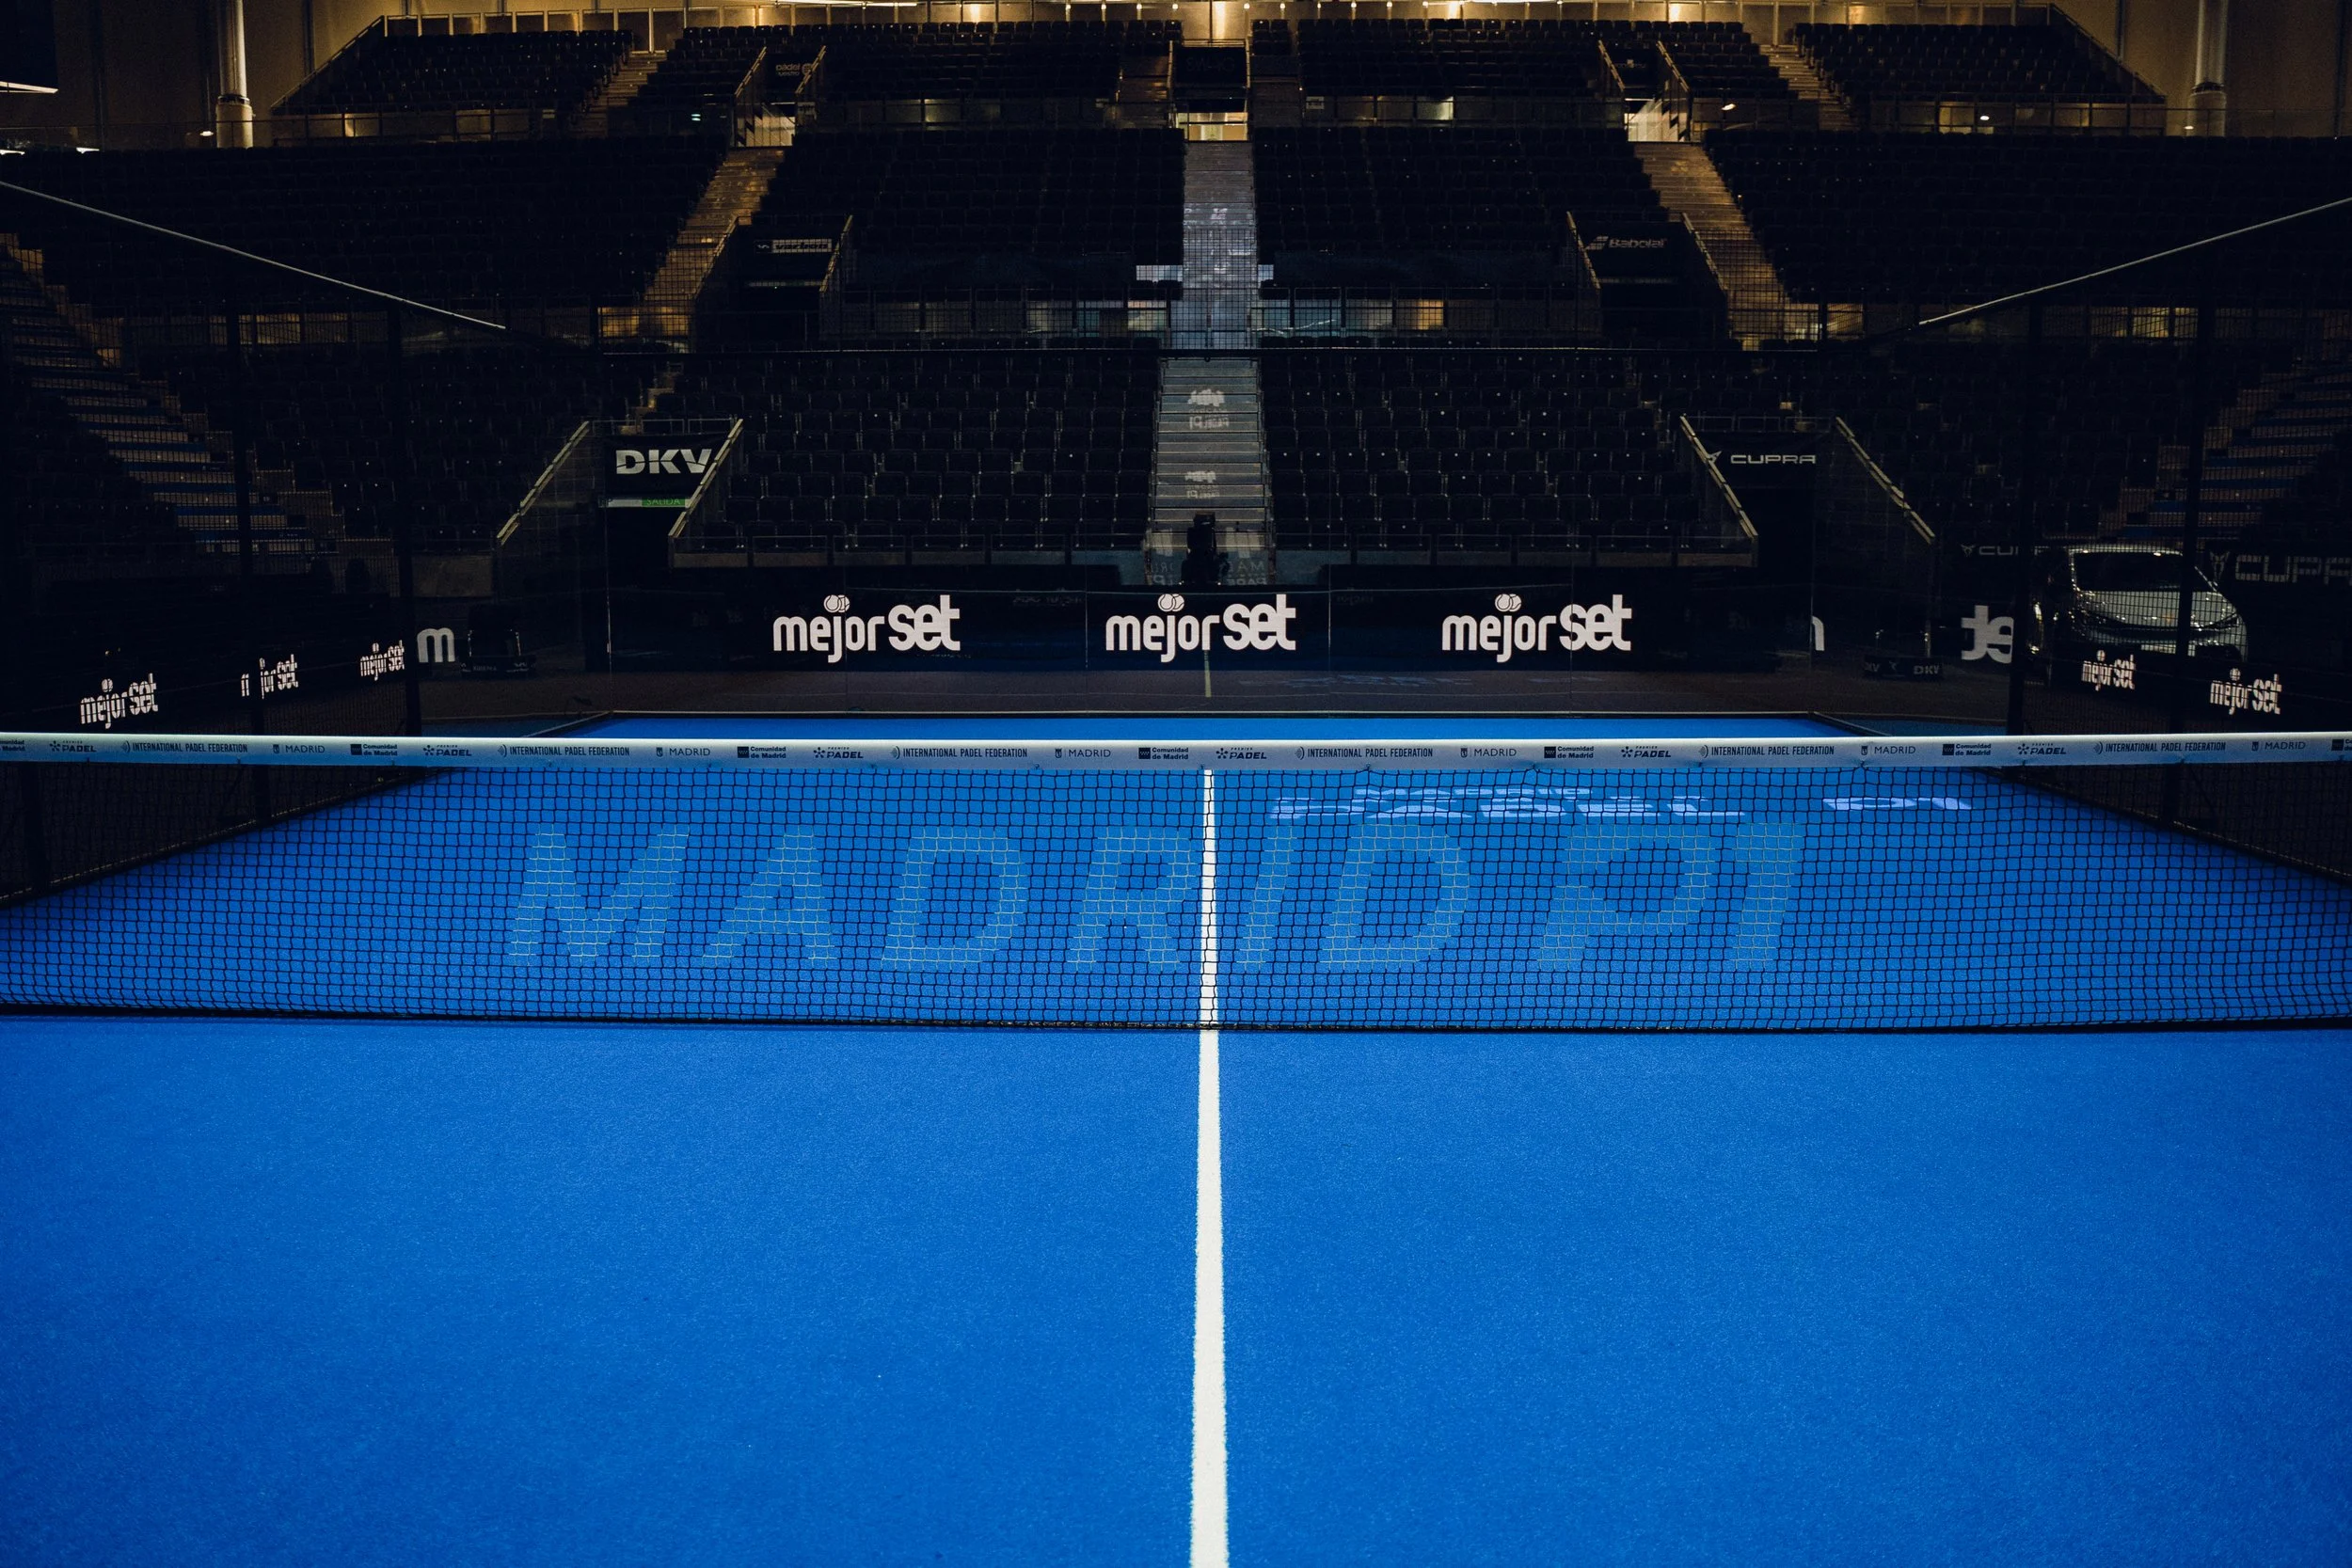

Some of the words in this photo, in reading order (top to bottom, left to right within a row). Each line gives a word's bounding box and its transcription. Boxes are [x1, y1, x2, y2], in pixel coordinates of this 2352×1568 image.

[615, 449, 712, 474] DKV
[1730, 454, 1817, 465] CUPRA
[62, 744, 96, 752] PADEL
[133, 742, 183, 752] INTERNATIONAL
[185, 742, 206, 752] PADEL
[208, 743, 247, 753] FEDERATION
[286, 745, 325, 753] MADRID
[1711, 746, 1765, 756] INTERNATIONAL
[1768, 746, 1789, 755] PADEL
[1792, 745, 1834, 755] FEDERATION
[1875, 746, 1915, 754] MADRID
[2030, 746, 2067, 754] PADEL
[2106, 742, 2157, 752] INTERNATIONAL
[2161, 742, 2182, 752] PADEL
[2185, 741, 2226, 752] FEDERATION
[2265, 741, 2306, 750] MADRID
[437, 748, 471, 756] PADEL
[510, 746, 562, 756] INTERNATIONAL
[564, 746, 586, 756] PADEL
[589, 746, 629, 756] FEDERATION
[670, 748, 710, 756] MADRID
[903, 748, 957, 758] INTERNATIONAL
[961, 748, 982, 758] PADEL
[985, 748, 1027, 758] FEDERATION
[1230, 751, 1267, 759] PADEL
[1308, 748, 1361, 758] INTERNATIONAL
[1366, 748, 1387, 758] PADEL
[1391, 748, 1433, 758] FEDERATION
[509, 824, 1470, 973] MADRID
